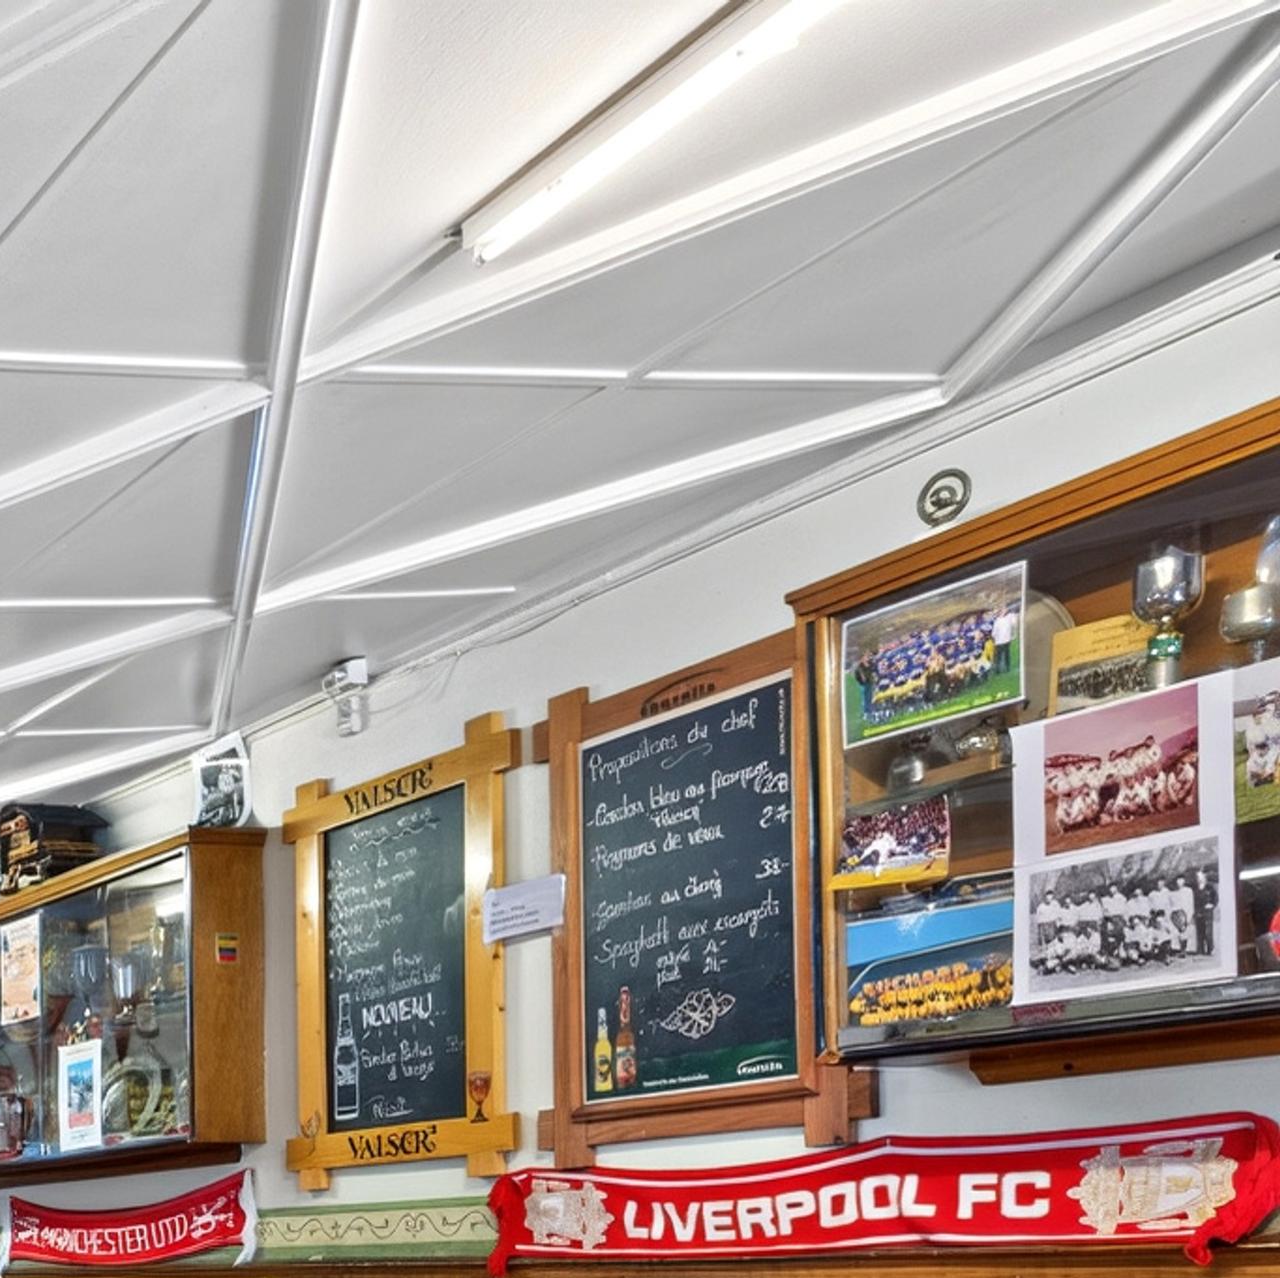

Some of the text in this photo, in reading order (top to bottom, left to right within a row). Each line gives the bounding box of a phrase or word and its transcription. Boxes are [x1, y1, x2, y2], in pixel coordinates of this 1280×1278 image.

[687, 721, 708, 745] du
[721, 698, 758, 733] chef
[623, 1171, 1051, 1242] LIVERPOOL FC
[41, 1213, 188, 1256] MANCHESTER UTD
